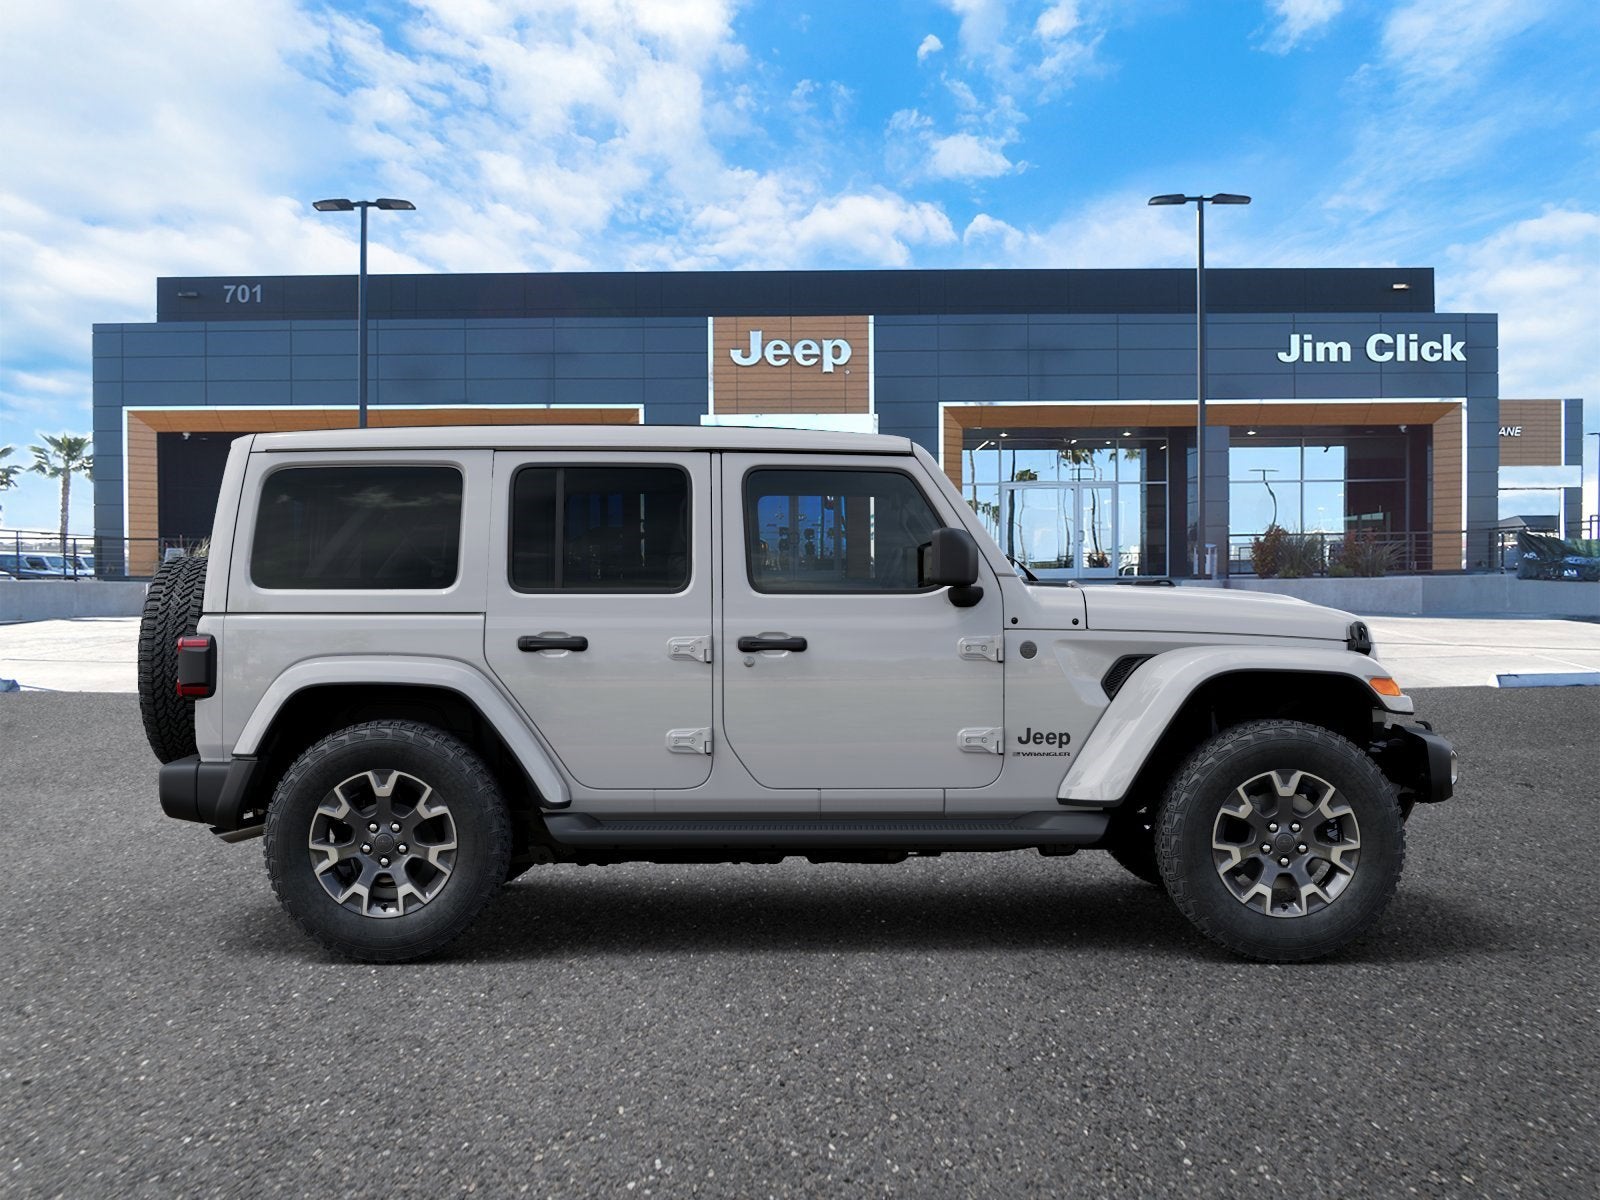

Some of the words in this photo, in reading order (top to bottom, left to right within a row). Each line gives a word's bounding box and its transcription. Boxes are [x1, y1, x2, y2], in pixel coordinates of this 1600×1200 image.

[223, 284, 262, 303] 701
[730, 330, 852, 373] Jeep
[1277, 334, 1351, 362] Jim
[1366, 333, 1467, 362] Click
[1017, 727, 1071, 748] Jeep
